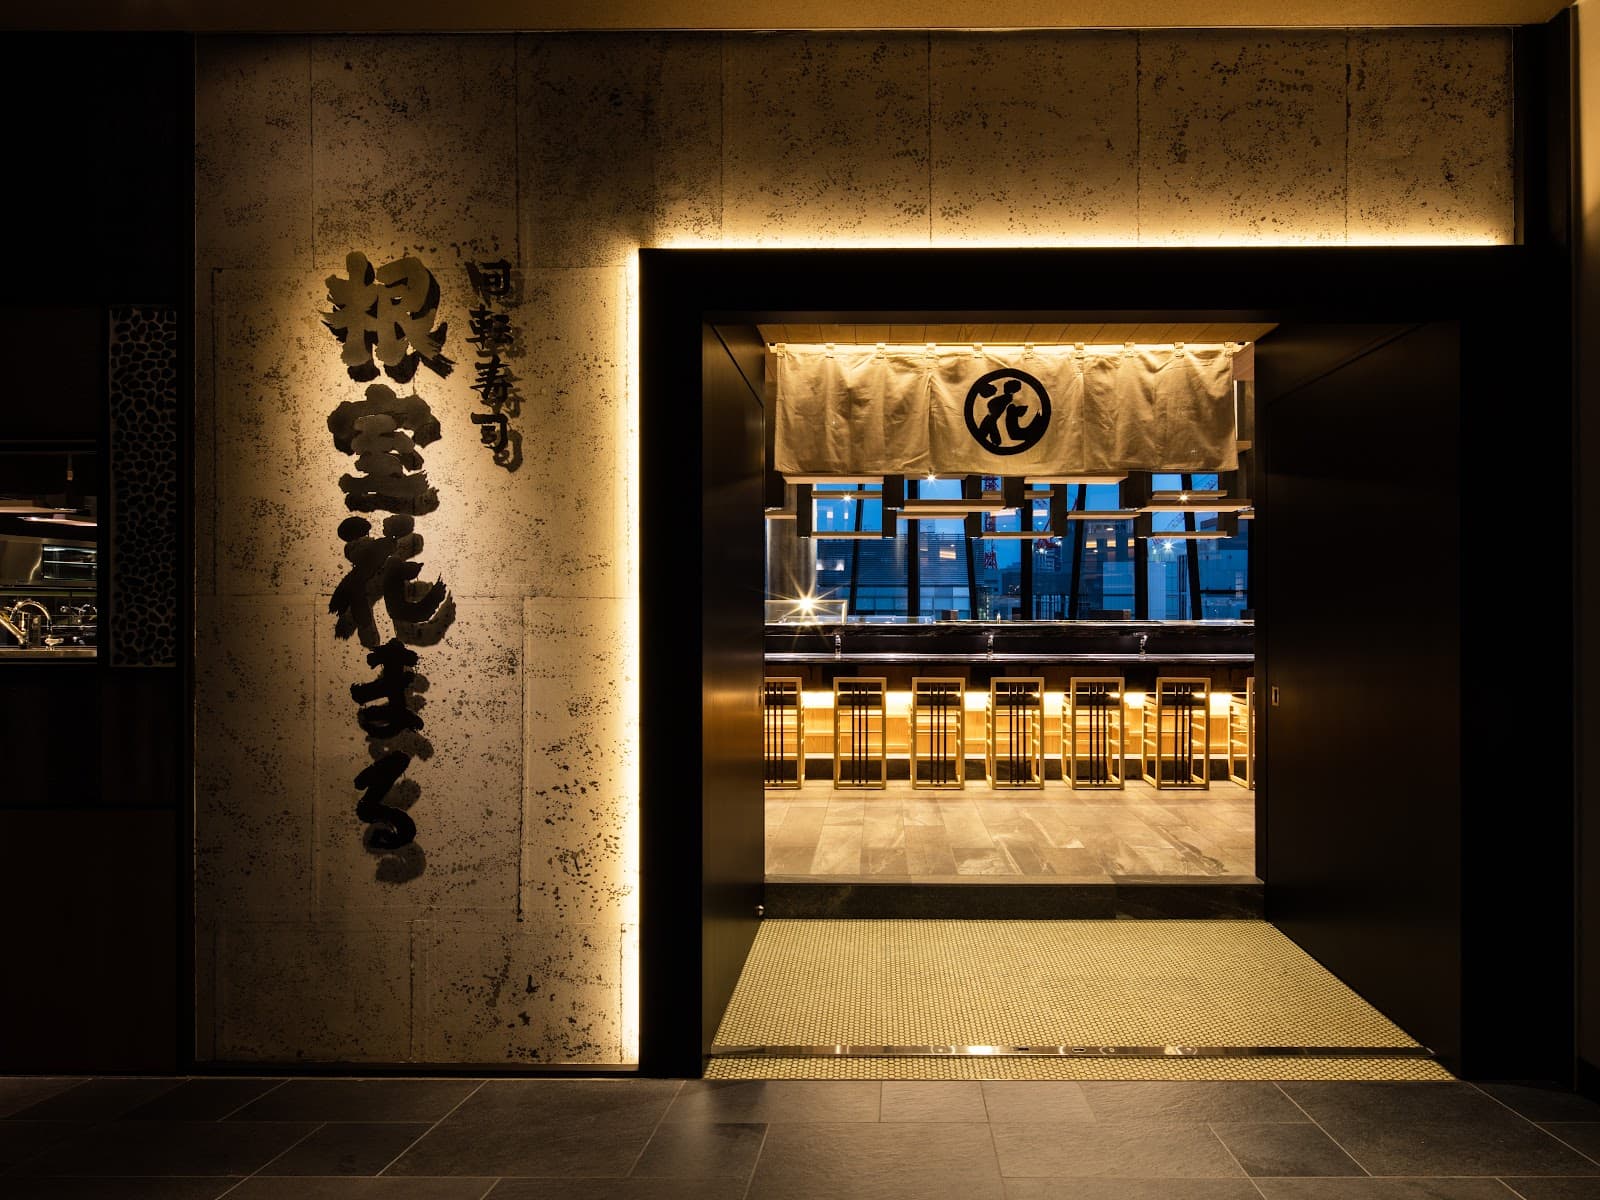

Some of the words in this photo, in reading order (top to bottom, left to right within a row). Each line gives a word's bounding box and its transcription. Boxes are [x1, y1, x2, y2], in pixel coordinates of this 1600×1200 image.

[320, 251, 448, 852] 根室花まる
[973, 379, 1047, 448] 花
